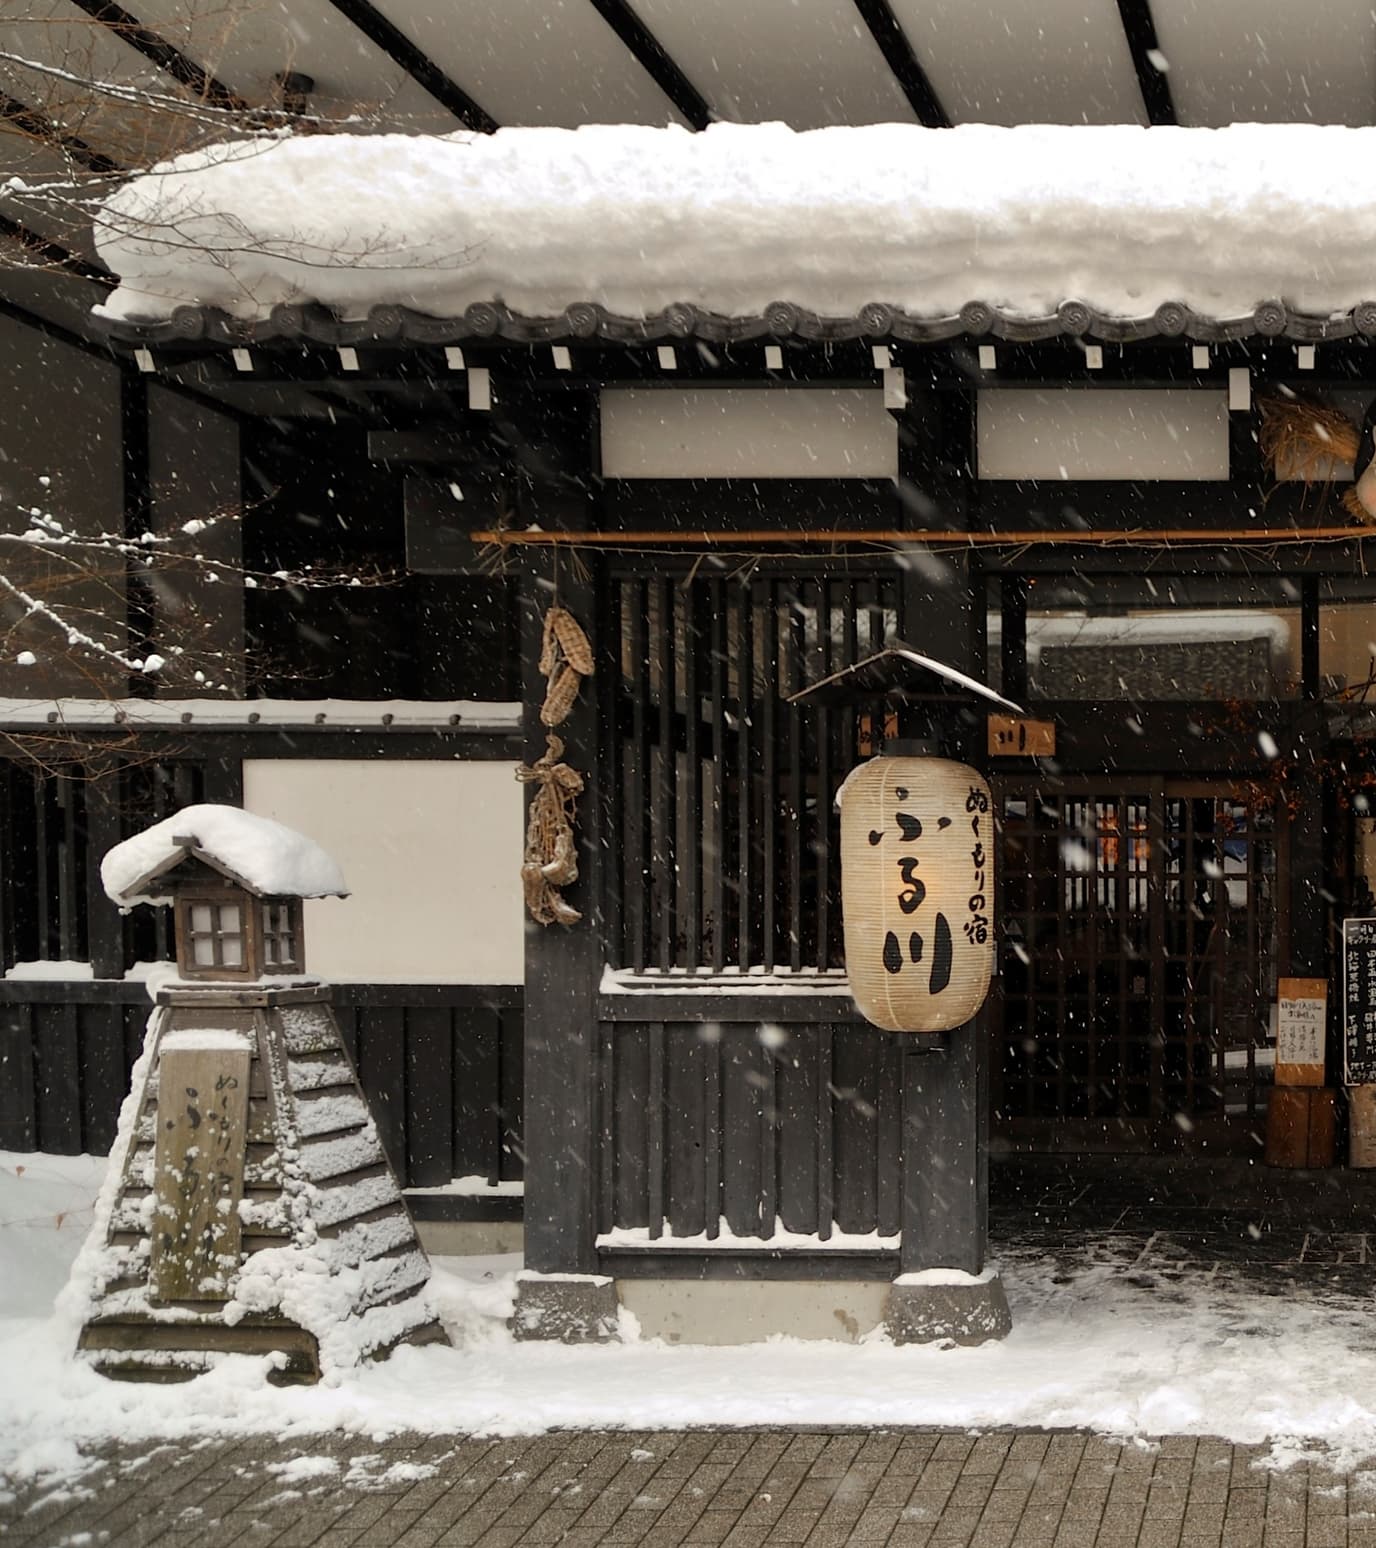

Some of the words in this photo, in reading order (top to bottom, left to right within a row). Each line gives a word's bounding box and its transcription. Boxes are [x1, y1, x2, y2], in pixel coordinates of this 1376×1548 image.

[868, 786, 953, 995] ふる川
[963, 786, 989, 945] ぬくもりの宿
